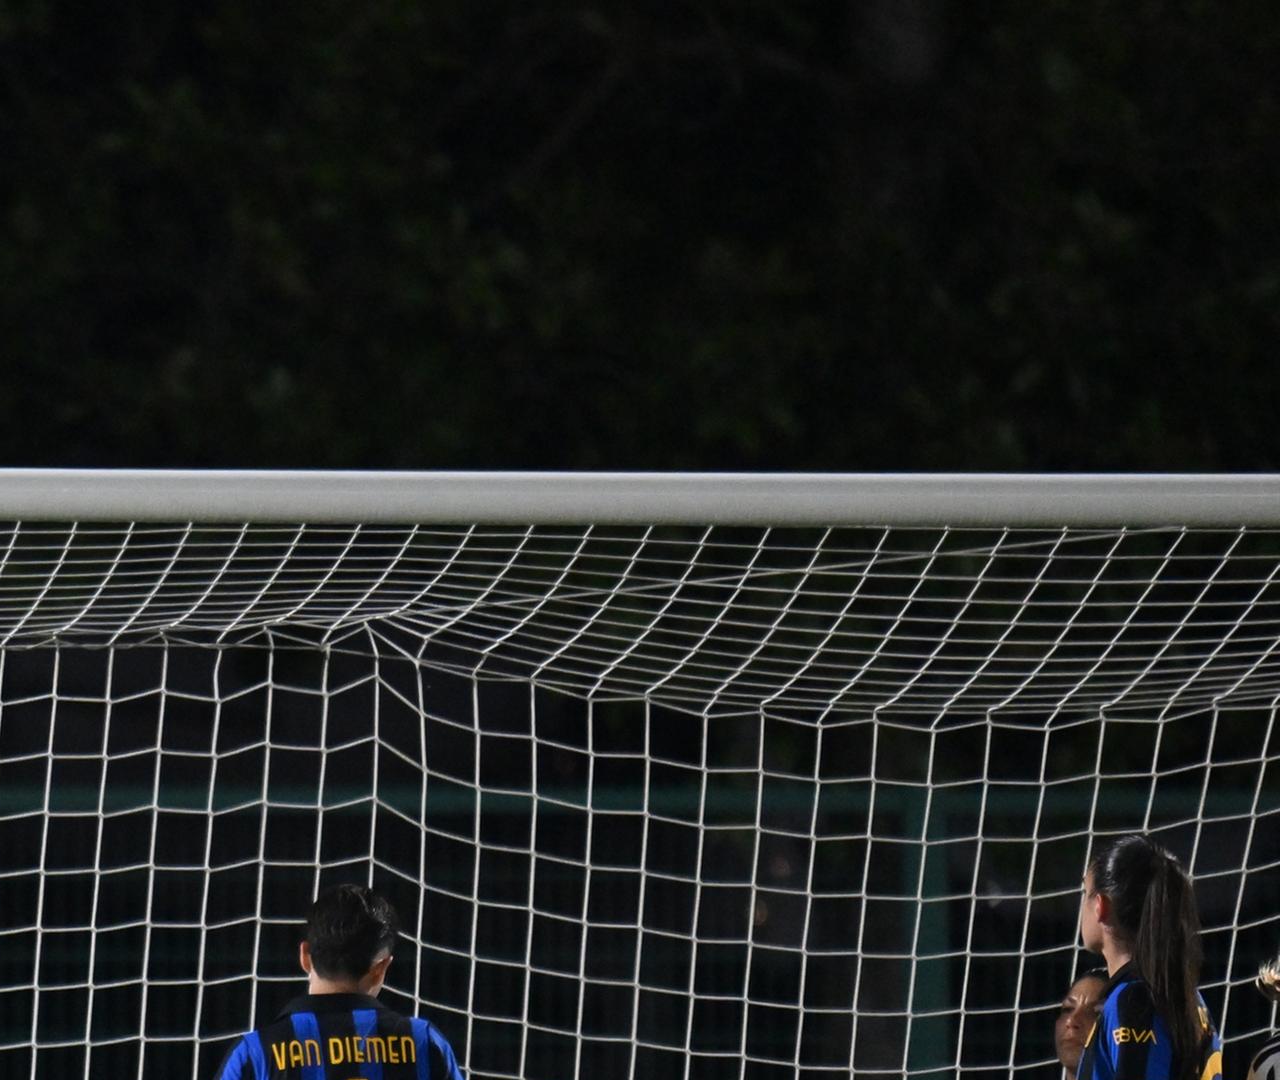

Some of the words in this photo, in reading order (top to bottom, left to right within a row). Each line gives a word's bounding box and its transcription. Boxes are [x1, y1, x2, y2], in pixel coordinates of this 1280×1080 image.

[1112, 1027, 1157, 1045] BBVA
[272, 1040, 322, 1071] VAN
[328, 1036, 416, 1065] DIEMEN
